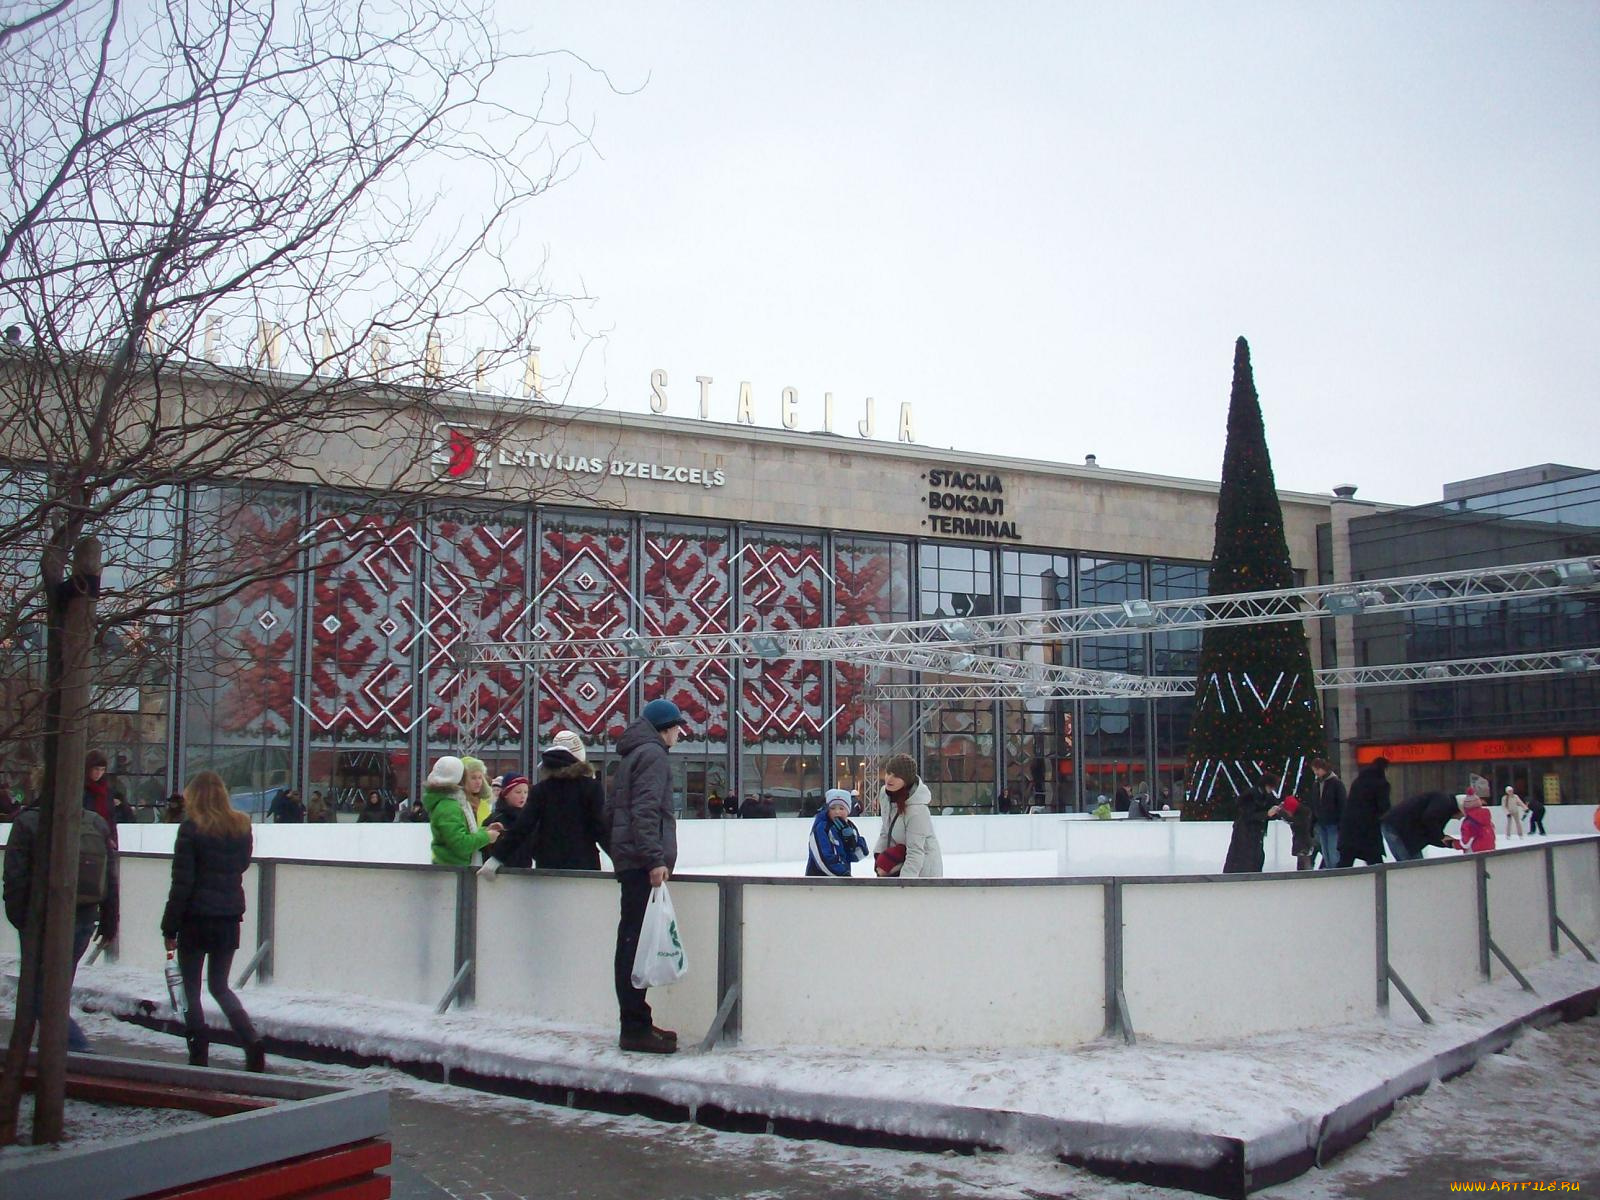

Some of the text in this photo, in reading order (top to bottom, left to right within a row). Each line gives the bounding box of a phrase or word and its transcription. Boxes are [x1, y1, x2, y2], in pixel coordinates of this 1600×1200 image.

[650, 369, 915, 444] STACIJA
[498, 449, 725, 489] LATVIJAS DZELZCEĻŠ
[929, 468, 1003, 493] STACIJA
[929, 491, 1004, 515] ВОКЗАЛ
[928, 514, 1022, 539] TERMINAL
